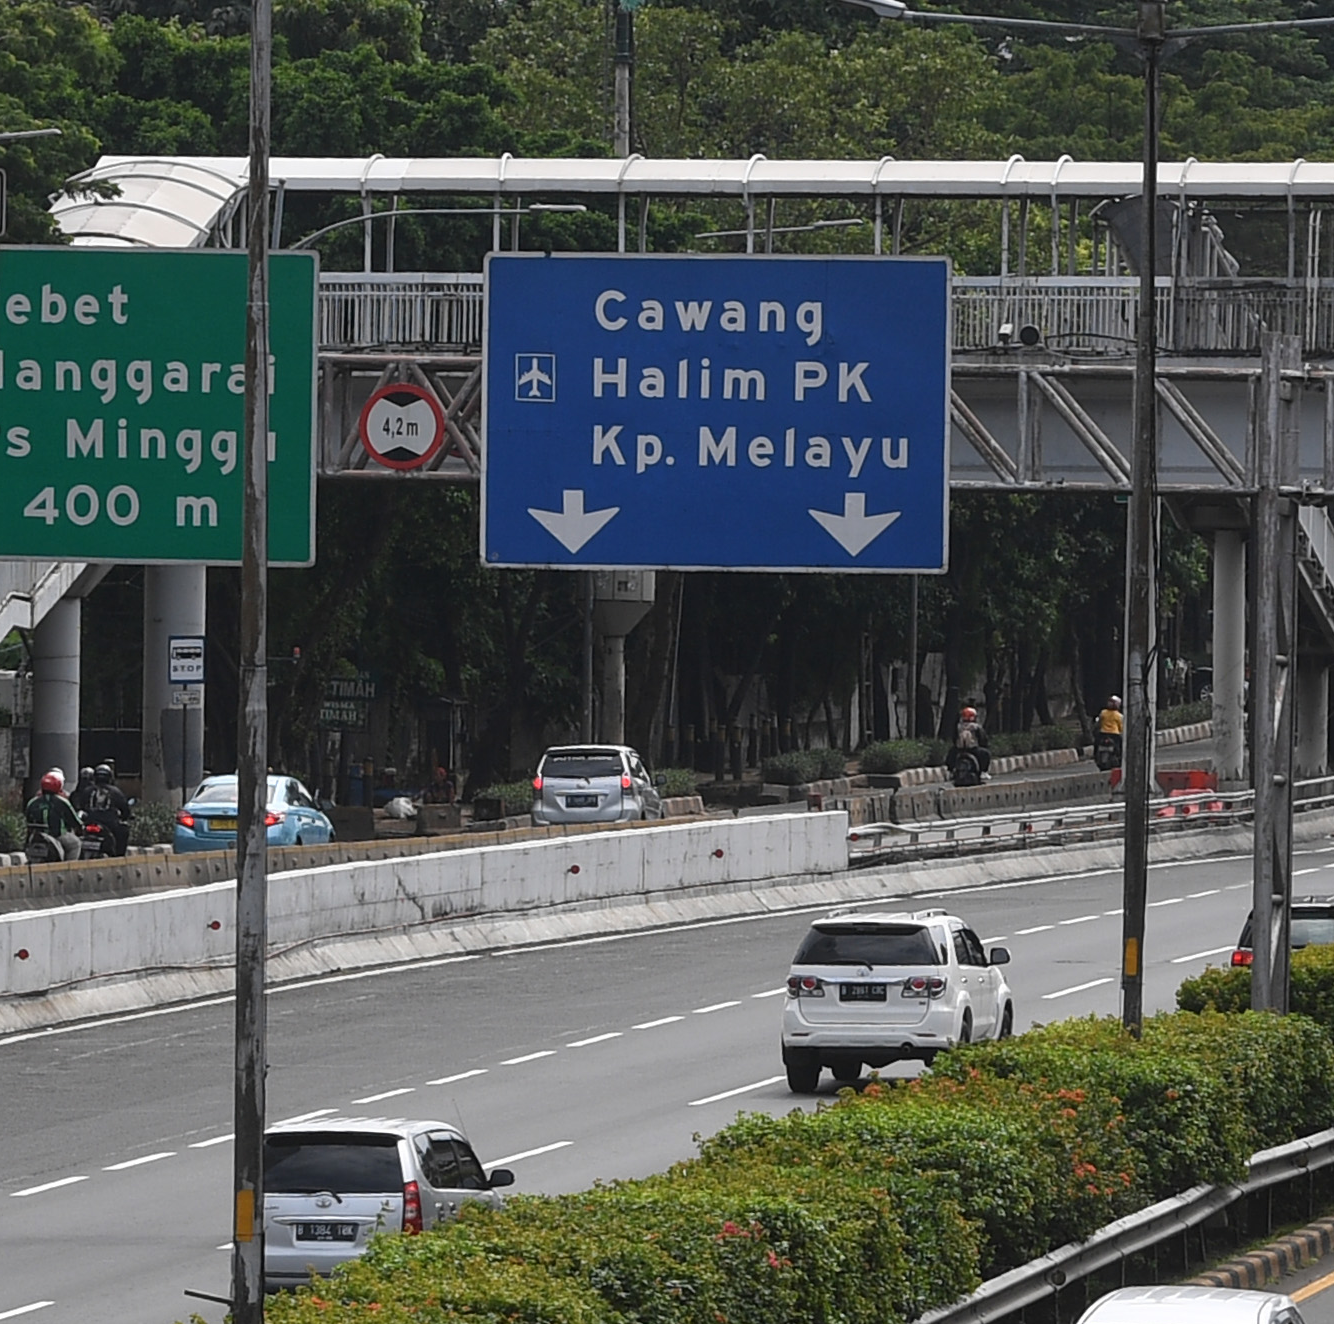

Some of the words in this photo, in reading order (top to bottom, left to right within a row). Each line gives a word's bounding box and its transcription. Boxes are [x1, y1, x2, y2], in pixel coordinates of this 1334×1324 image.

[594, 289, 823, 346] Cawang
[593, 357, 765, 401] Halim
[794, 361, 871, 402] PK
[593, 424, 675, 474] Kp.
[699, 425, 909, 478] Melayu
[23, 485, 140, 527] 400
[175, 495, 219, 528] m
[172, 664, 202, 673] STOP
